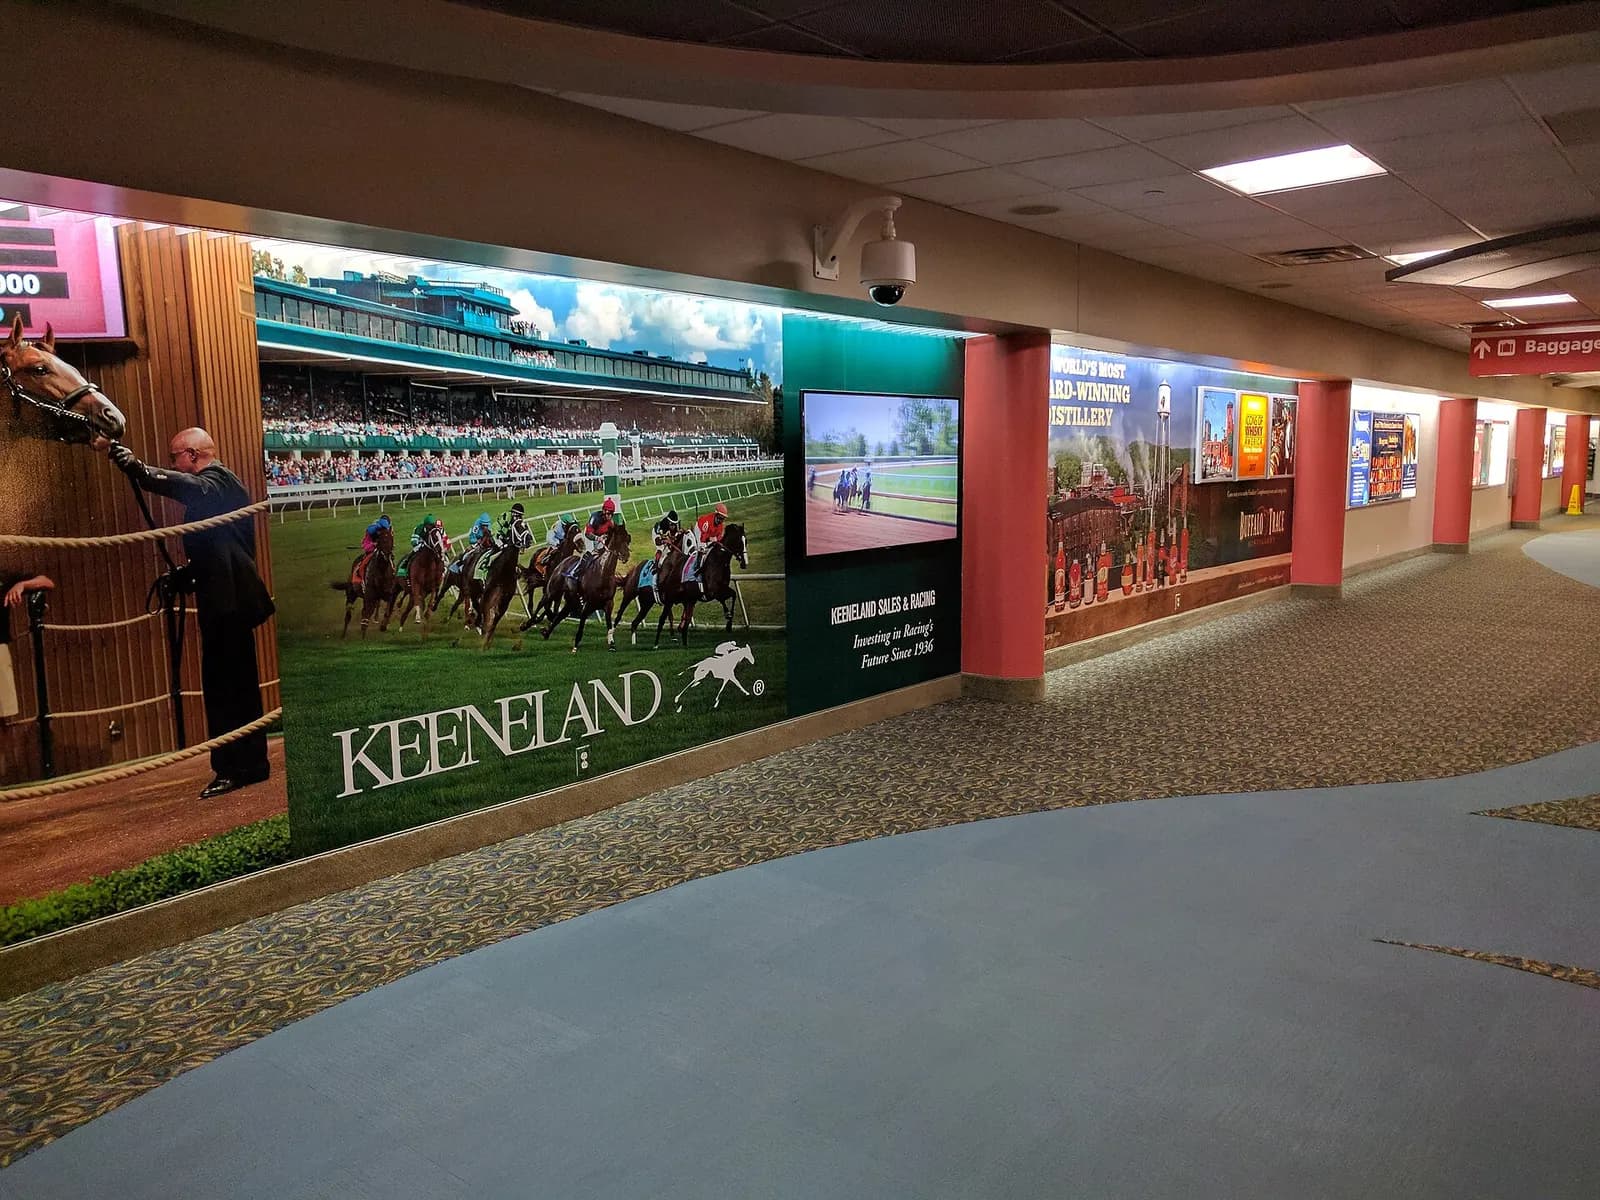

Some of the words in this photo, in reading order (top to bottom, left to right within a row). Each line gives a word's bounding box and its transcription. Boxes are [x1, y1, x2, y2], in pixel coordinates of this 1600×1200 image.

[1525, 339, 1600, 355] Baggage
[1053, 358, 1098, 377] WORLD'S
[1099, 361, 1127, 379] MOST
[1049, 406, 1113, 427] ISTILLERY
[1239, 511, 1264, 540] BUFFALO
[1269, 507, 1286, 536] TRACE
[831, 601, 877, 625] KEENELAND
[878, 596, 902, 616] SALES
[903, 596, 909, 611] &
[910, 590, 936, 610] RACING
[853, 630, 892, 649] Investing
[893, 627, 902, 640] in
[903, 618, 934, 637] Racing's
[861, 654, 890, 669] Future
[891, 648, 913, 662] Since
[914, 639, 935, 656] 1936
[333, 670, 661, 798] KEENELAND
